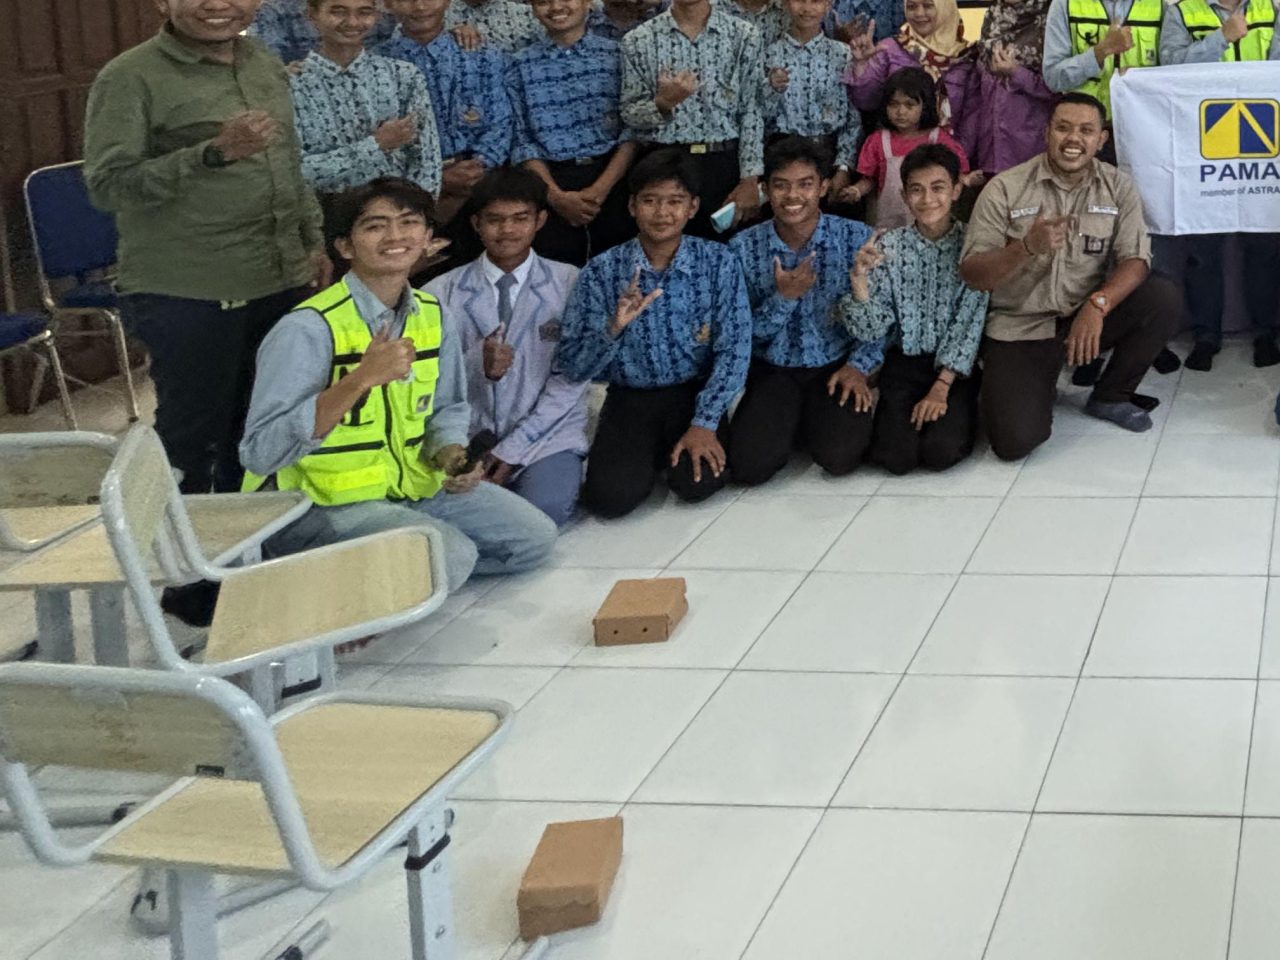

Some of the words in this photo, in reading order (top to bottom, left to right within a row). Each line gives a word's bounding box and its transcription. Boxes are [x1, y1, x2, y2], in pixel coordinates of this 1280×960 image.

[1200, 162, 1280, 183] PAMA
[1200, 188, 1236, 197] member
[1247, 186, 1280, 195] ASTRA
